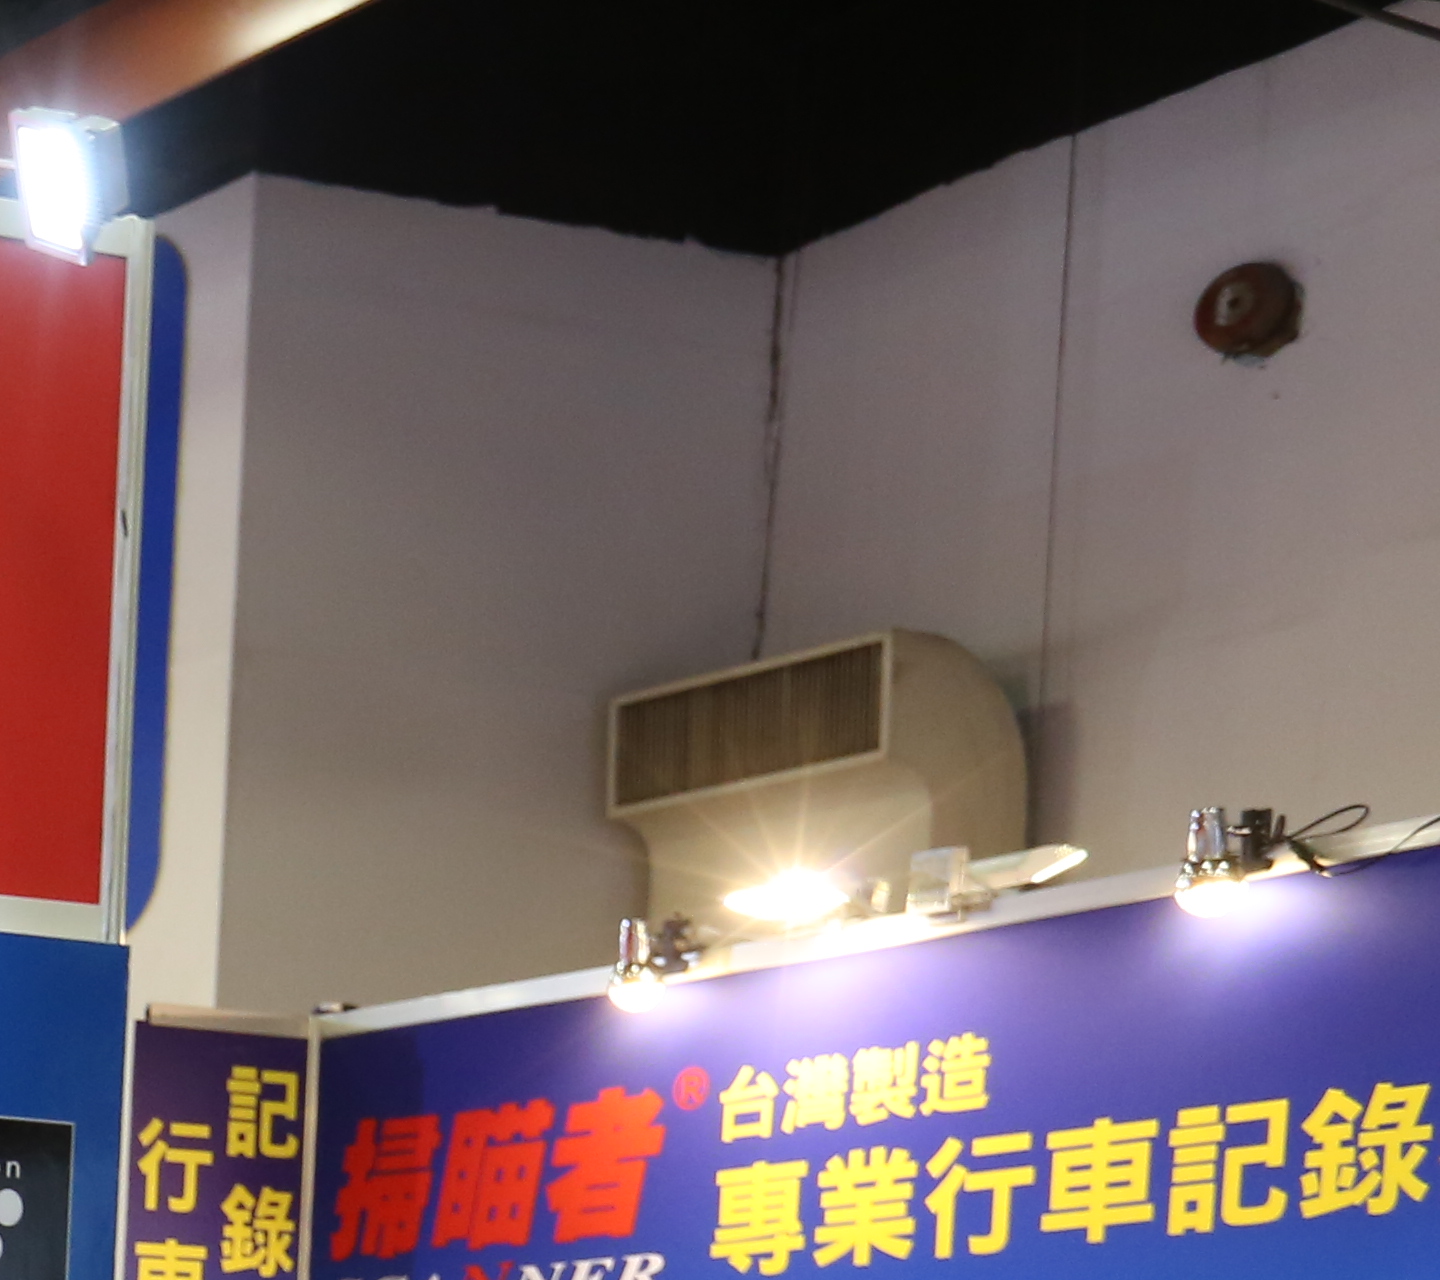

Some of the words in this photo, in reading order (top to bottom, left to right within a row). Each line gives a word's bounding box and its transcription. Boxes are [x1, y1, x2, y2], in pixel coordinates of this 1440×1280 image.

[328, 1084, 668, 1265] 掃瞄者
[708, 1078, 1434, 1279] 專業行車記錄
[717, 1031, 993, 1145] 台灣製造
